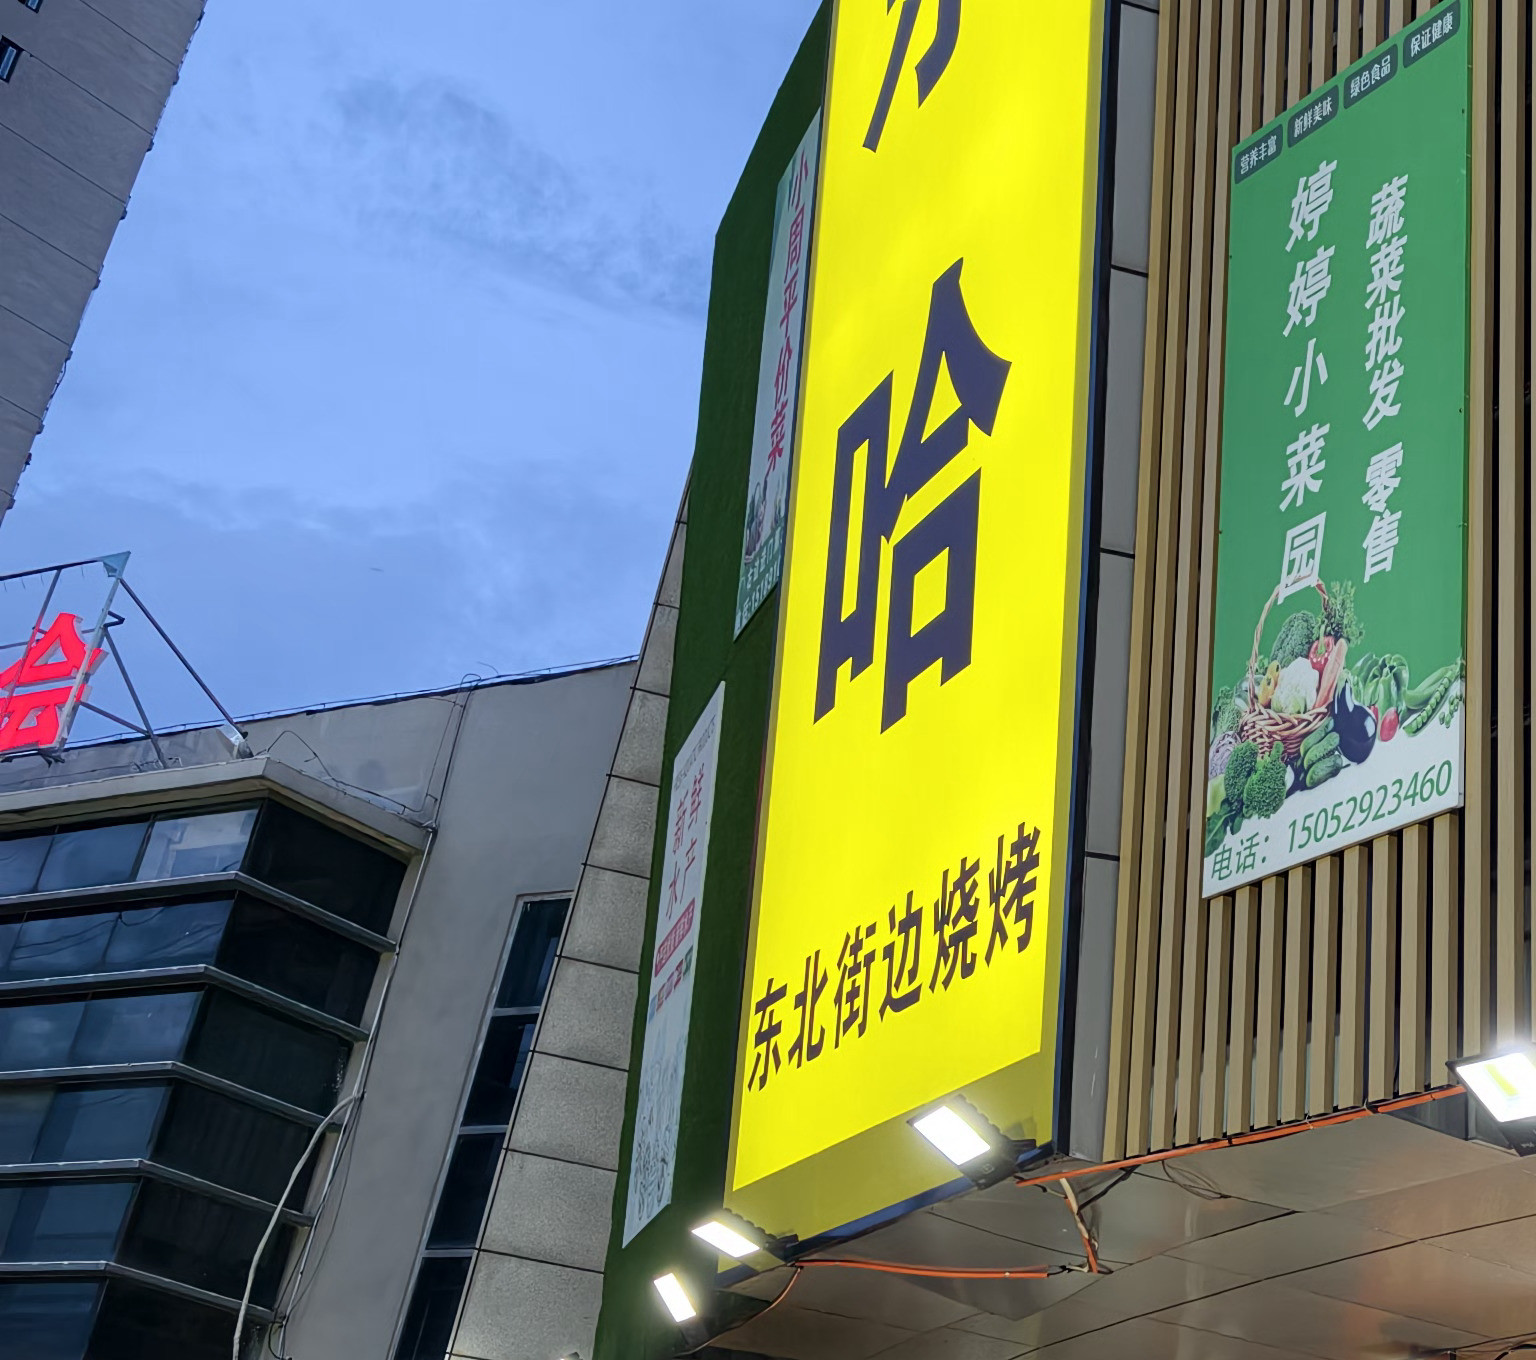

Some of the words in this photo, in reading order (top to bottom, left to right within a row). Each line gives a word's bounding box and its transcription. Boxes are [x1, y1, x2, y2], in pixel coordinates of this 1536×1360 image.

[1350, 54, 1391, 98] 绿色食品
[1410, 11, 1454, 58] 保证健康
[1240, 135, 1277, 175] 营养丰富
[1293, 96, 1333, 138] 新鲜美味
[1361, 173, 1408, 431] 蔬菜批发
[1277, 159, 1338, 606] 婷婷小菜园
[1361, 441, 1404, 585] 零售
[1287, 759, 1453, 854] 15052923460
[745, 820, 1042, 1094] 东北街边烧烤
